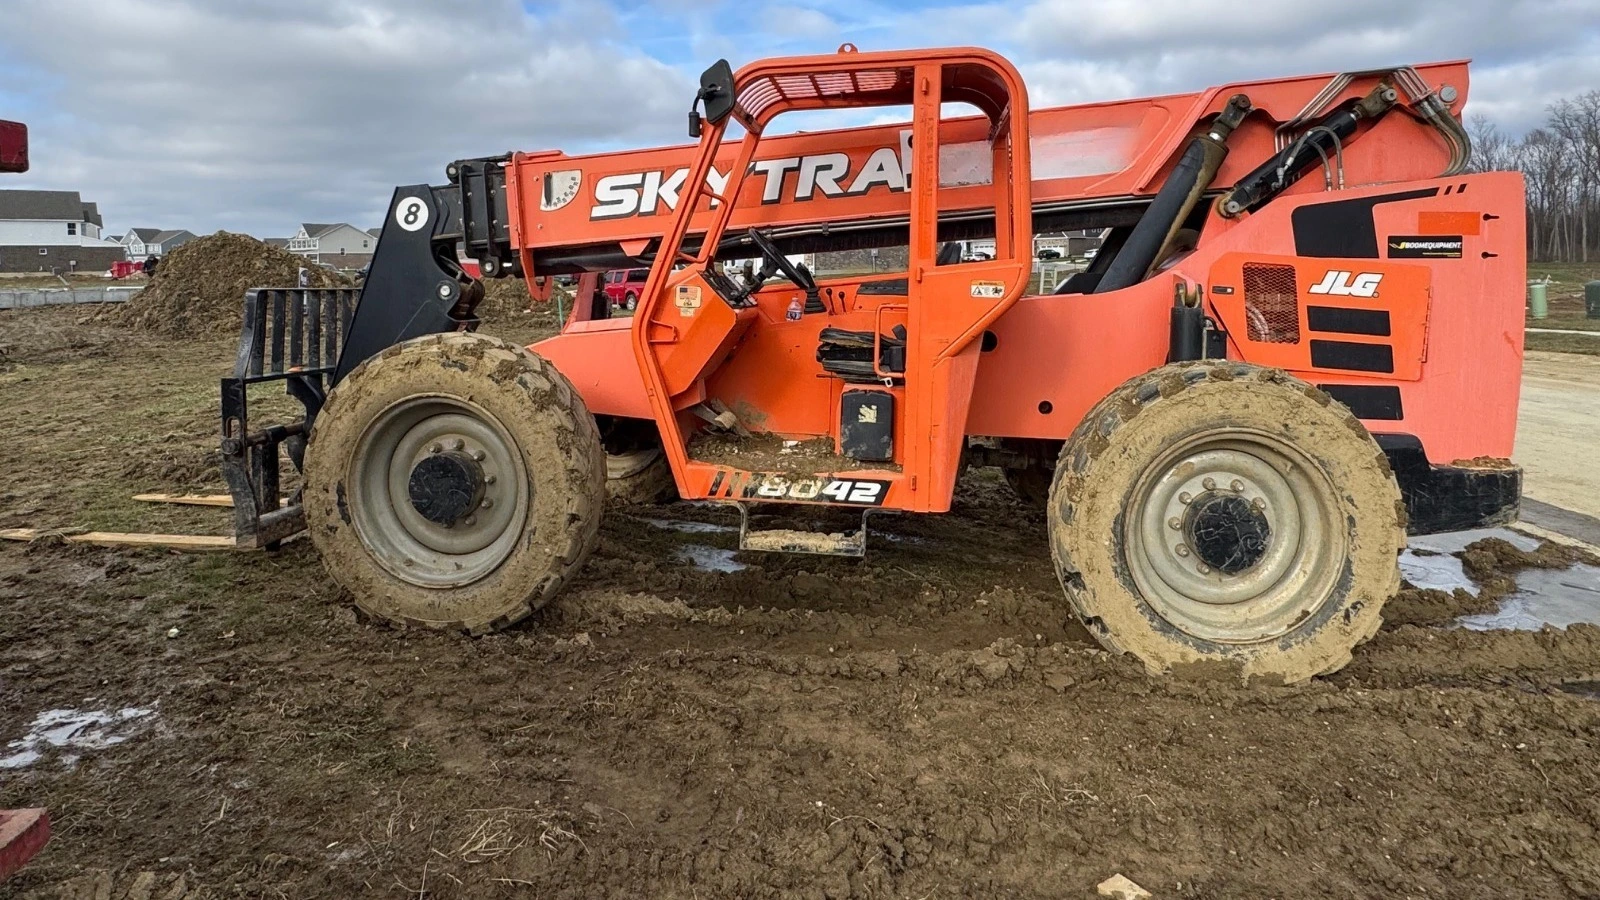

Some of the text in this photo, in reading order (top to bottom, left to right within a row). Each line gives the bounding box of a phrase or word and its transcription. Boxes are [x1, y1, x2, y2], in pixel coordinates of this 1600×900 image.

[590, 148, 906, 221] SKYTRA
[403, 202, 421, 225] 8
[1307, 270, 1384, 298] JLG
[758, 476, 882, 502] 8042
